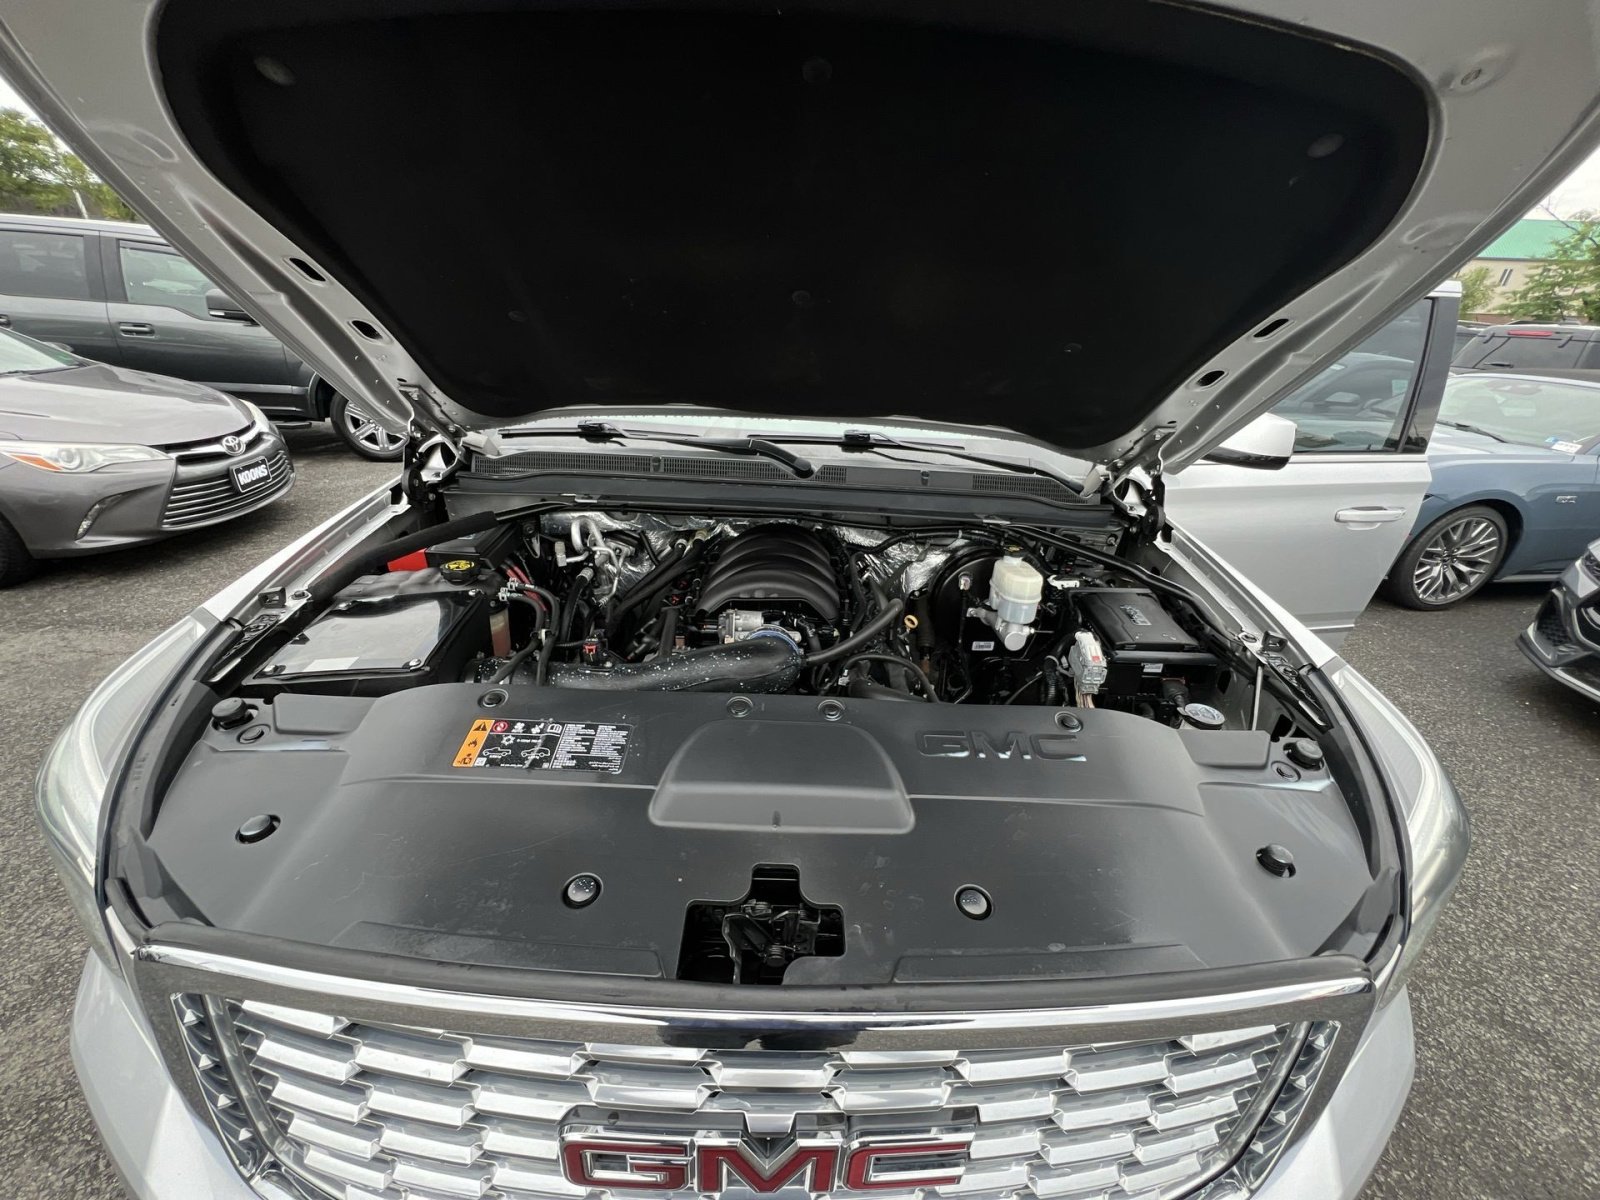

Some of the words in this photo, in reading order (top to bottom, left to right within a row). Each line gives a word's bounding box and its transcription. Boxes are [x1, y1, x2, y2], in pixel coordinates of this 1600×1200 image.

[237, 464, 268, 486] KOONS
[916, 731, 1087, 762] GMC
[560, 1130, 972, 1194] GMC
